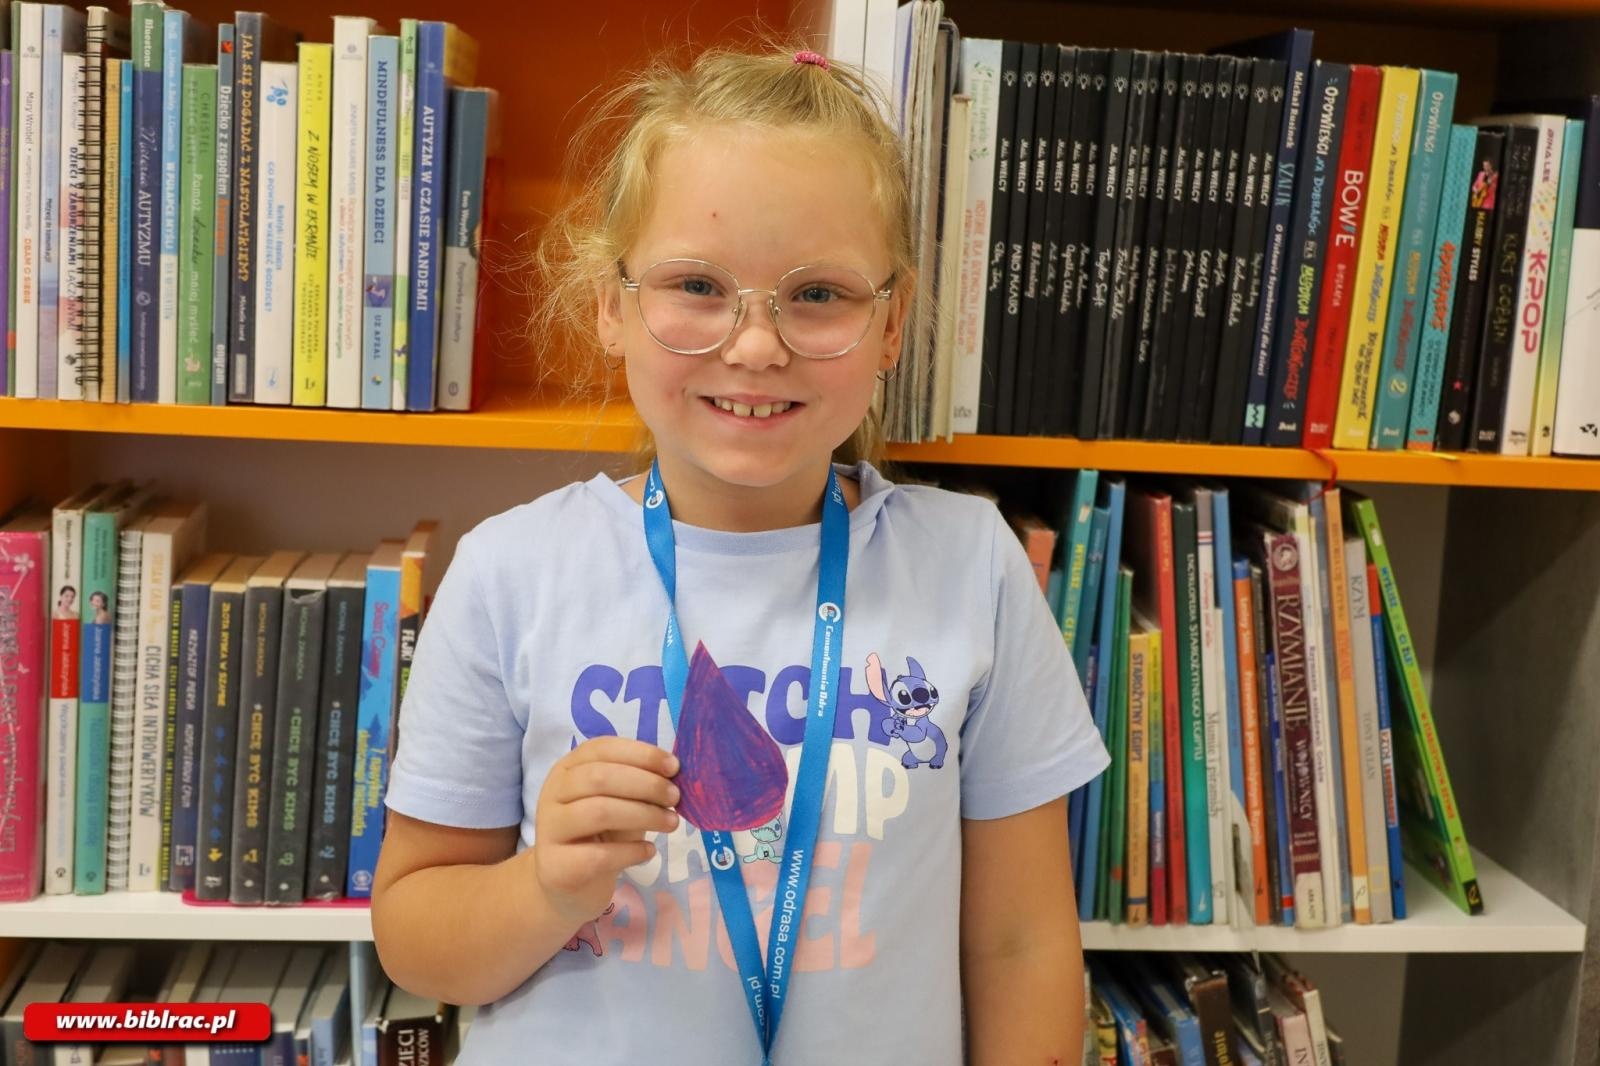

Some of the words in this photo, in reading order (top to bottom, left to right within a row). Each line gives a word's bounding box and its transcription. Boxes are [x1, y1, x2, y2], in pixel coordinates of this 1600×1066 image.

[143, 18, 154, 68] Bluestone
[240, 34, 254, 59] JAK
[238, 65, 252, 86] SIĘ
[1292, 71, 1303, 106] Michał
[25, 92, 34, 111] Mary
[219, 86, 232, 129] Dziecko
[376, 61, 387, 161] MINDFULNESS
[25, 114, 34, 144] Wrobel
[200, 93, 210, 155] CHRISTEL
[240, 91, 252, 151] DOGADAĆ
[421, 106, 434, 166] AUTYZM
[1286, 108, 1298, 148] Rusinek
[1316, 86, 1339, 155] OPOWIEŚCI
[70, 147, 78, 178] DZIECI
[217, 142, 231, 195] zespołem
[240, 155, 250, 163] Z
[304, 146, 319, 188] NOSEM
[1542, 161, 1551, 184] LEE
[375, 166, 385, 193] DLA
[421, 171, 431, 183] W
[998, 160, 1007, 192] WIELCY
[1017, 160, 1026, 193] WIELCY
[1035, 160, 1044, 192] WIELCY
[1054, 160, 1062, 193] WIELCY
[1070, 163, 1079, 195] WIELCY
[1085, 163, 1095, 195] WIELCY
[1106, 166, 1115, 198] WIELCY
[1125, 168, 1135, 200] WIELCY
[1139, 166, 1148, 198] WIELCY
[1156, 168, 1165, 200] WIELCY
[1174, 169, 1183, 201] WIELCY
[1192, 170, 1201, 202] WIELCY
[1208, 170, 1218, 202] WIELCY
[1225, 172, 1235, 204] WIELCY
[1244, 175, 1254, 207] WIELCY
[1260, 174, 1270, 206] WIELCY
[418, 187, 432, 238] CZASIE
[462, 190, 470, 207] Ewa
[68, 192, 78, 265] ZABURZENIAMI
[137, 189, 152, 266] AUTYZMU
[237, 167, 251, 281] NASTOLATKIEM?
[305, 209, 321, 260] EKRANIE
[373, 198, 386, 244] DZIECI
[416, 242, 430, 311] PANDEMII
[1061, 244, 1075, 277] Agatha
[1094, 249, 1110, 280] Taylor
[1115, 248, 1128, 283] Frida
[1200, 250, 1212, 276] Coco
[1468, 247, 1481, 281] STYLES
[189, 271, 200, 302] mniej
[1092, 282, 1107, 308] Swift
[1111, 284, 1124, 320] Kahlo
[1194, 276, 1208, 318] Chanel
[1520, 250, 1548, 353] K-POP
[1261, 334, 1270, 349] dla
[214, 344, 225, 384] engram
[1257, 350, 1268, 376] dzieci
[1390, 379, 1407, 393] 2
[1351, 575, 1366, 620] RZYM
[222, 602, 231, 629] ZŁOTA
[372, 602, 389, 632] Sean
[189, 628, 199, 677] KRZYSZTOF
[220, 631, 230, 659] RYBKA
[368, 636, 386, 678] Covey
[1186, 553, 1196, 622] ENCYKLOPEDIA
[1192, 721, 1204, 761] EGIPTU
[145, 646, 161, 681] CICHA
[219, 662, 227, 671] W
[1276, 593, 1308, 731] RZYMIANIE
[144, 684, 162, 710] SIŁA
[1130, 653, 1145, 725] STAROŻYTNY
[249, 712, 263, 749] CHCĘ
[288, 716, 302, 753] CHCĘ
[328, 710, 341, 746] CHCĘ
[1206, 712, 1221, 755] Mumie
[1131, 730, 1143, 763] EGIPT
[139, 715, 160, 817] INTROWERTYKÓW
[769, 850, 804, 999] www.odrasa.com.pl
